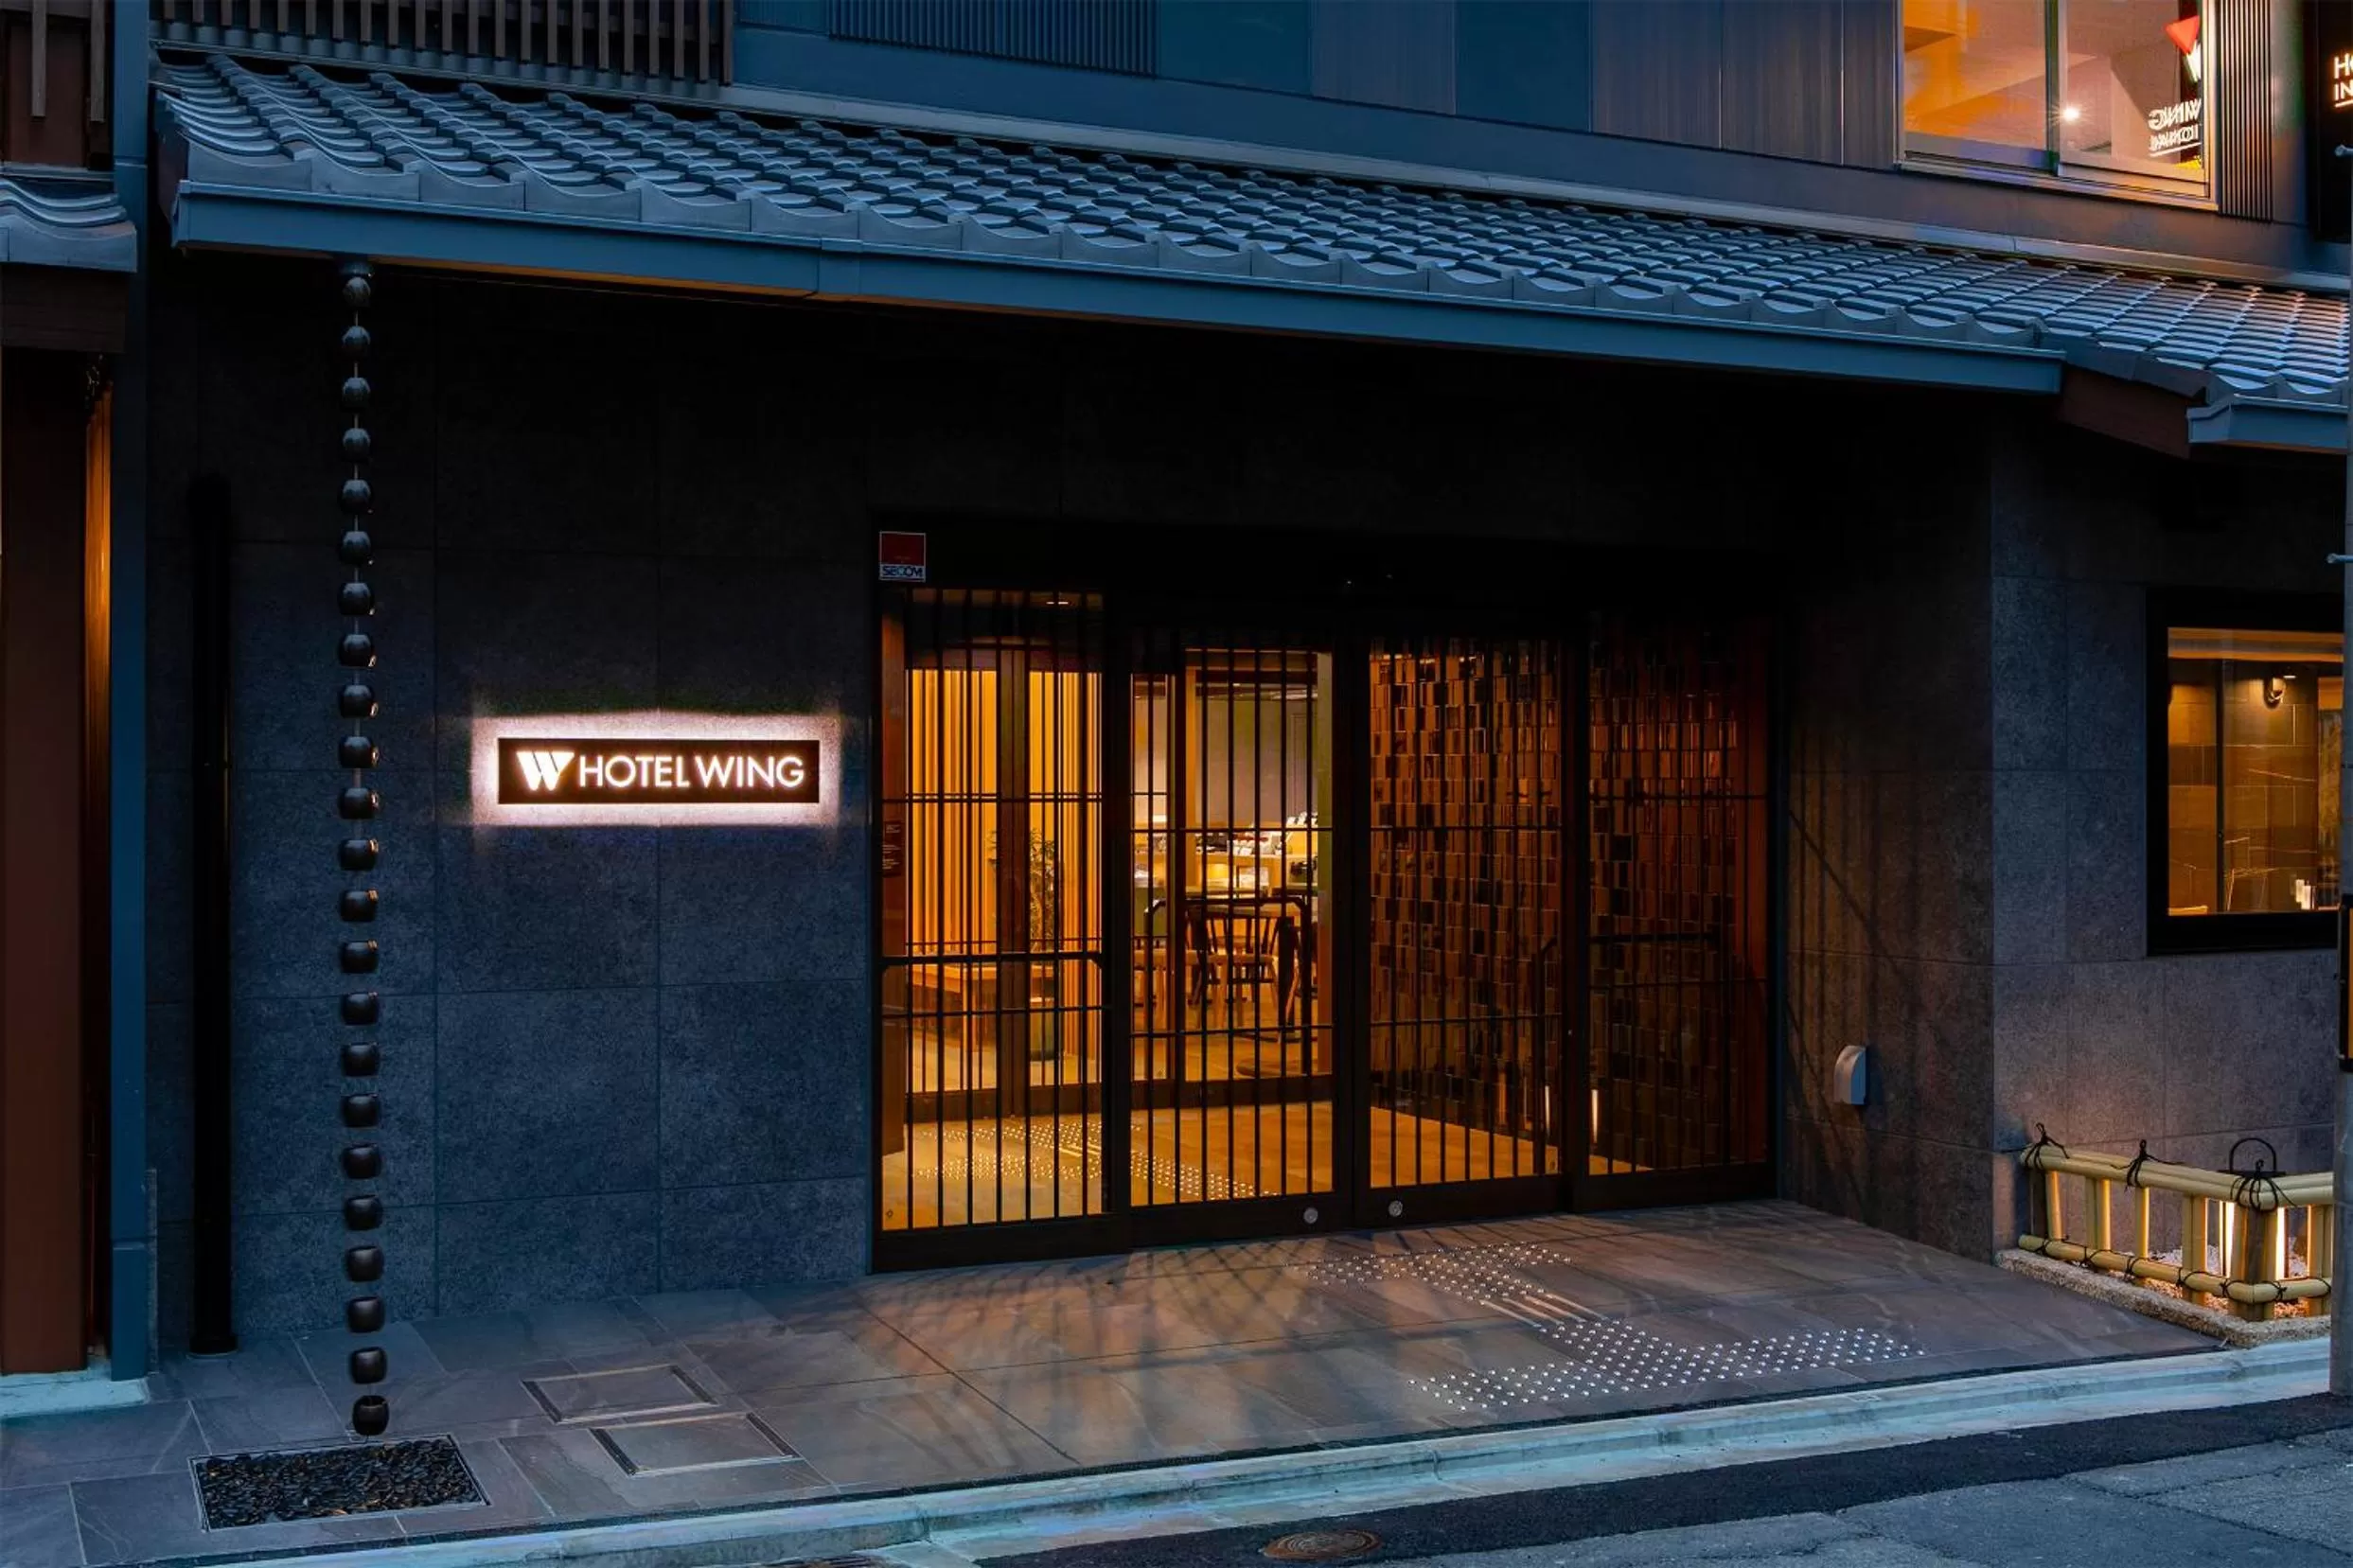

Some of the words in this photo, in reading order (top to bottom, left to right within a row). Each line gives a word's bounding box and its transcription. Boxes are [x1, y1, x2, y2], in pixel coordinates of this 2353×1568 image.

[882, 565, 922, 579] SECOM
[579, 755, 689, 788] HOTEL
[696, 755, 805, 788] WING
